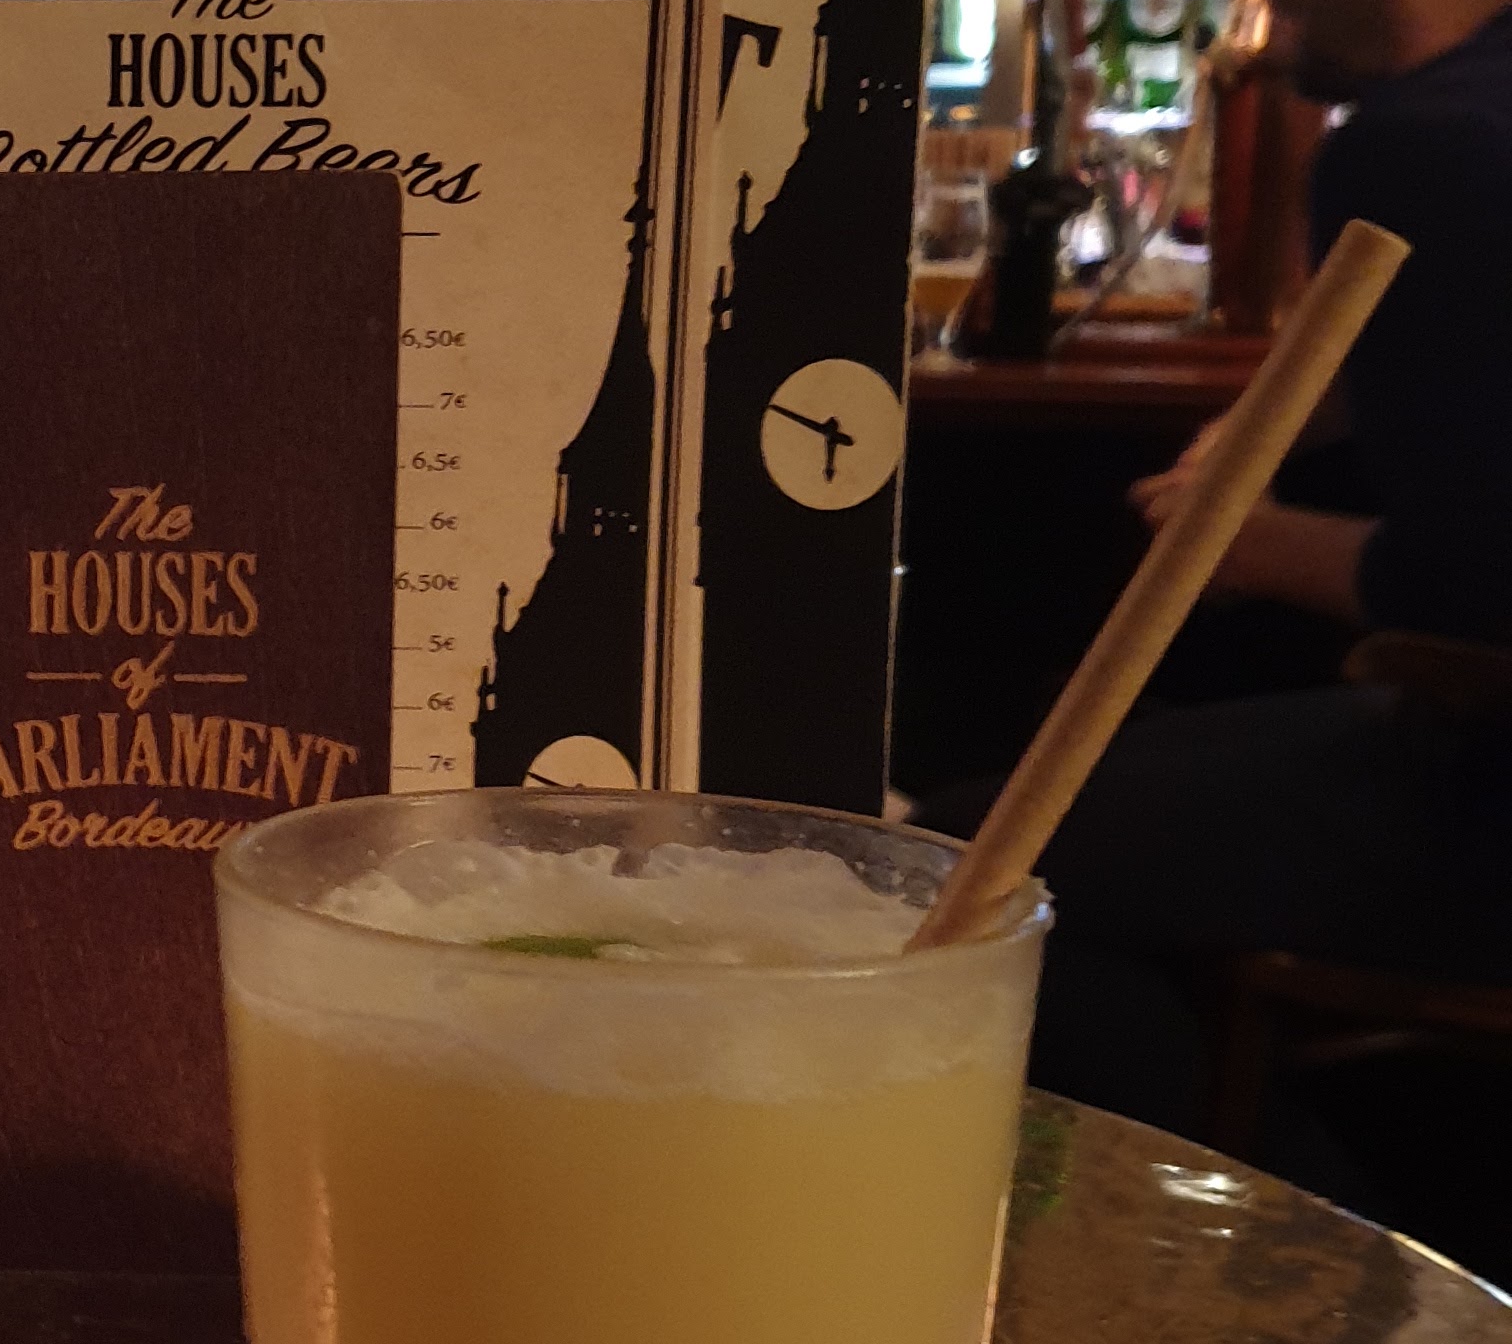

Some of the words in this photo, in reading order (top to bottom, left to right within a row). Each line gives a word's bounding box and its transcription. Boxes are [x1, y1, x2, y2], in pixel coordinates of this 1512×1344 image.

[107, 33, 327, 108] HOUSES
[402, 328, 466, 348] 6,50€
[440, 392, 467, 410] 7€
[412, 451, 461, 471] 6,5€
[94, 483, 193, 541] The
[430, 512, 458, 531] 6€
[394, 571, 459, 591] 6,50€
[28, 549, 259, 638] HOUSES
[428, 634, 456, 652] 5€
[111, 640, 176, 710] of
[426, 691, 456, 711] 6€
[428, 755, 456, 773] 7€
[12, 798, 246, 851] Bordeau
